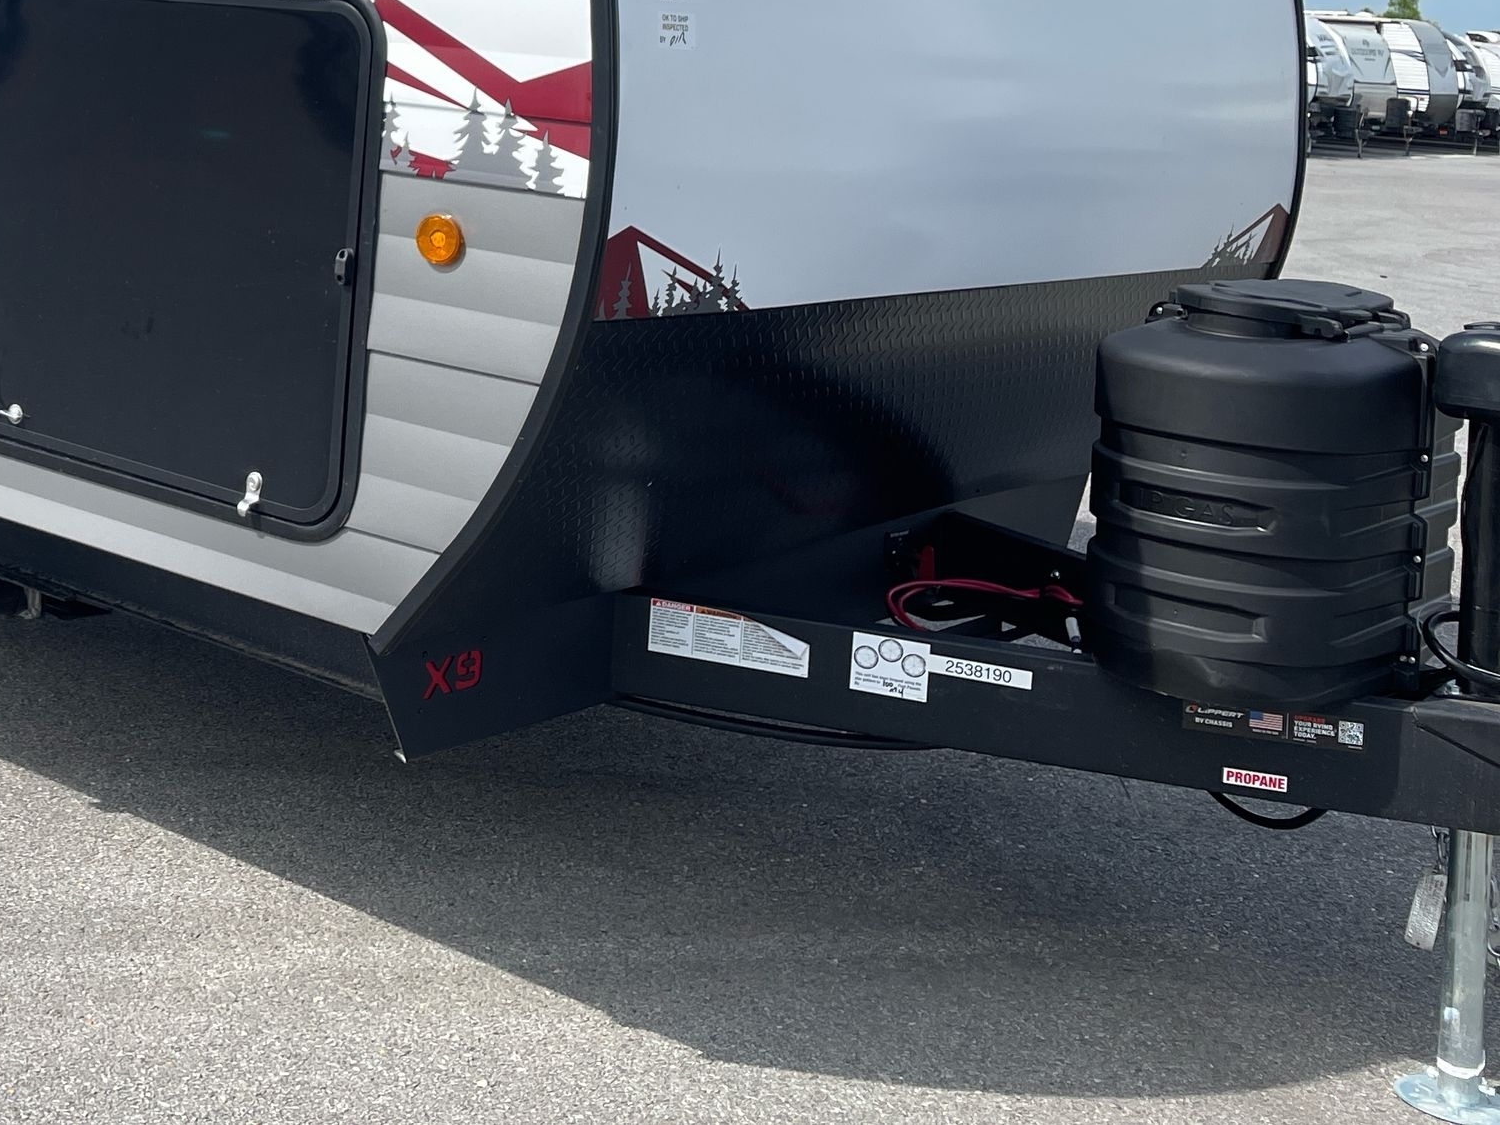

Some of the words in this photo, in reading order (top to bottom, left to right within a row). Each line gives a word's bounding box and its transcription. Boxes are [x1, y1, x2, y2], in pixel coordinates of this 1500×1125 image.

[1172, 496, 1235, 525] GAS
[661, 601, 691, 612] DANGER
[422, 650, 483, 700] X9
[945, 660, 1012, 684] 2538190
[1197, 707, 1245, 719] LIPPERT
[1204, 718, 1233, 728] CHASSIS
[1294, 720, 1312, 728] YOUR
[1294, 731, 1316, 740] TODAY.
[1226, 770, 1285, 789] PROPANE
